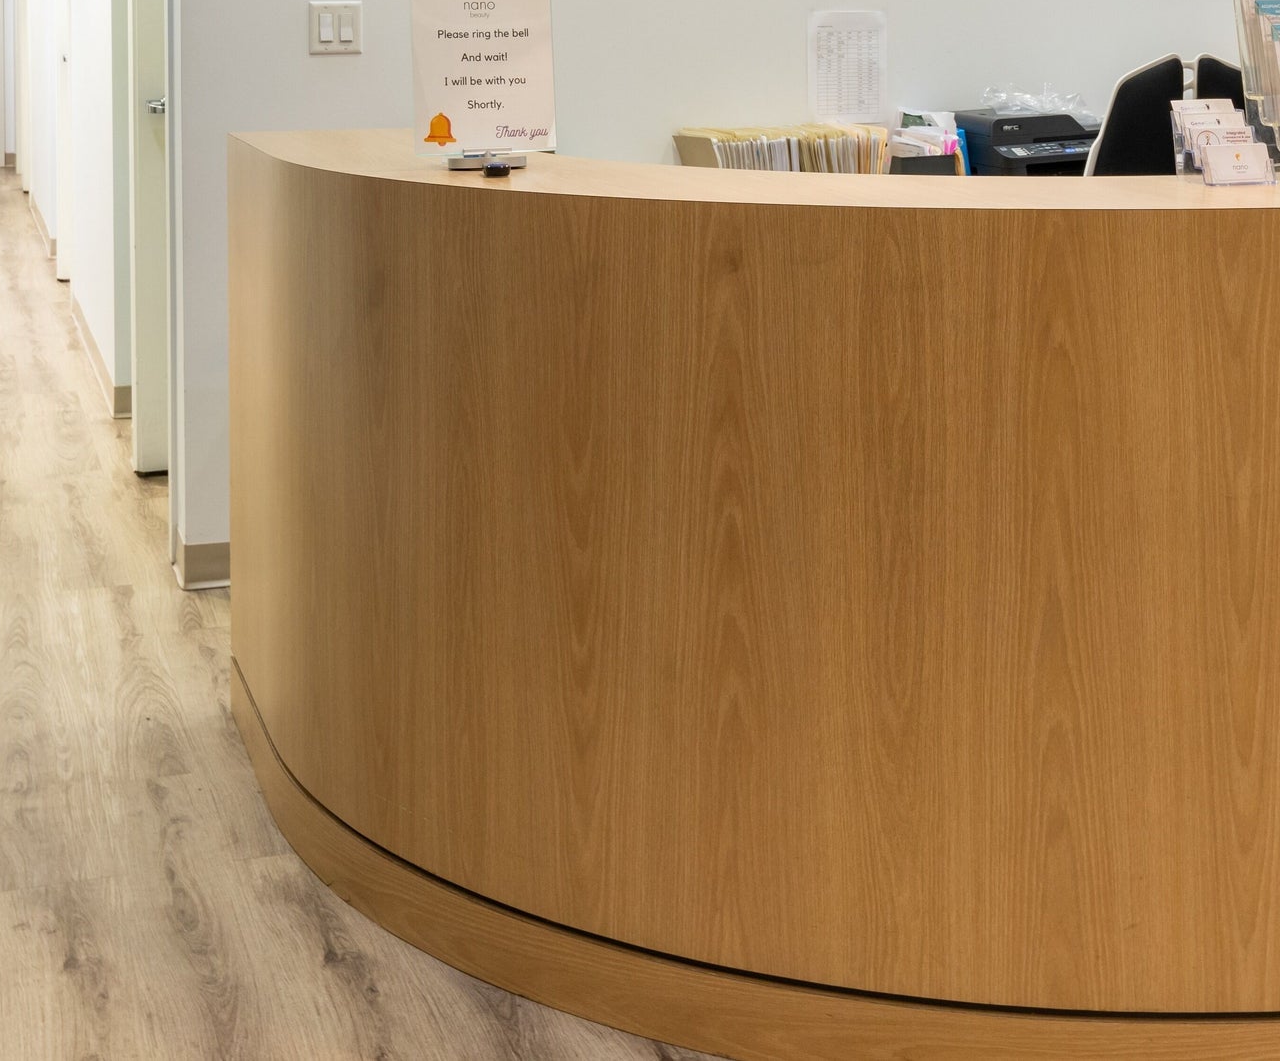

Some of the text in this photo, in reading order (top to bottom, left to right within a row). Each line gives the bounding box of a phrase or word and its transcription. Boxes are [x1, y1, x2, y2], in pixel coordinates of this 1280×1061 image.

[463, 0, 496, 10] nano
[437, 28, 529, 40] Please ring the bell
[461, 52, 508, 62] And wait!
[451, 76, 467, 86] will
[470, 76, 482, 86] be
[485, 76, 506, 86] with
[509, 78, 526, 88] you
[467, 100, 504, 110] Shortly.
[496, 125, 549, 140] Thank you
